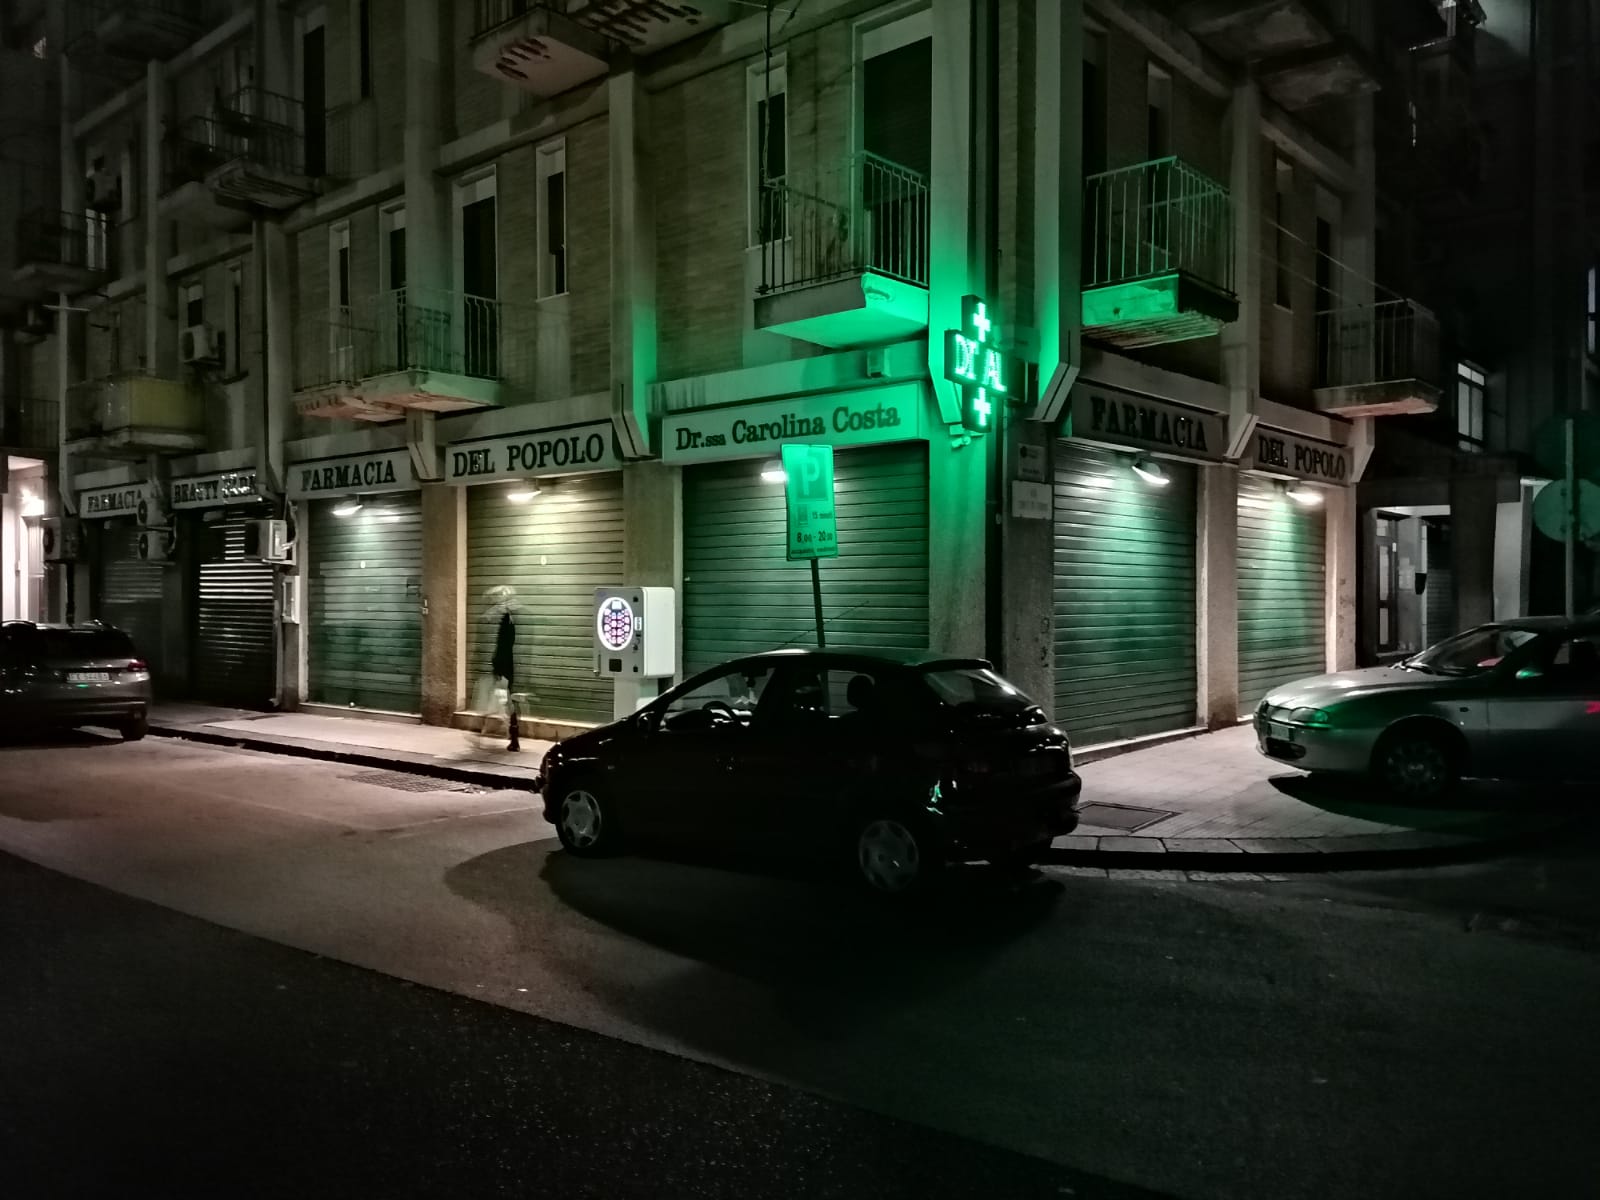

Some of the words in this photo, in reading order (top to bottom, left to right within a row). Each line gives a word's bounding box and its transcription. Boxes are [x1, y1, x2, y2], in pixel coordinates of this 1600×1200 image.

[732, 413, 826, 444] Carolina
[832, 403, 900, 432] Costa
[1091, 395, 1208, 453] FARMACIA
[301, 459, 396, 492] FARMACIA
[453, 446, 495, 477] DEL
[506, 432, 605, 471] POPOLO
[1258, 434, 1289, 468] DEL
[1294, 443, 1347, 480] POPOLO
[174, 480, 219, 503] BEAUTY
